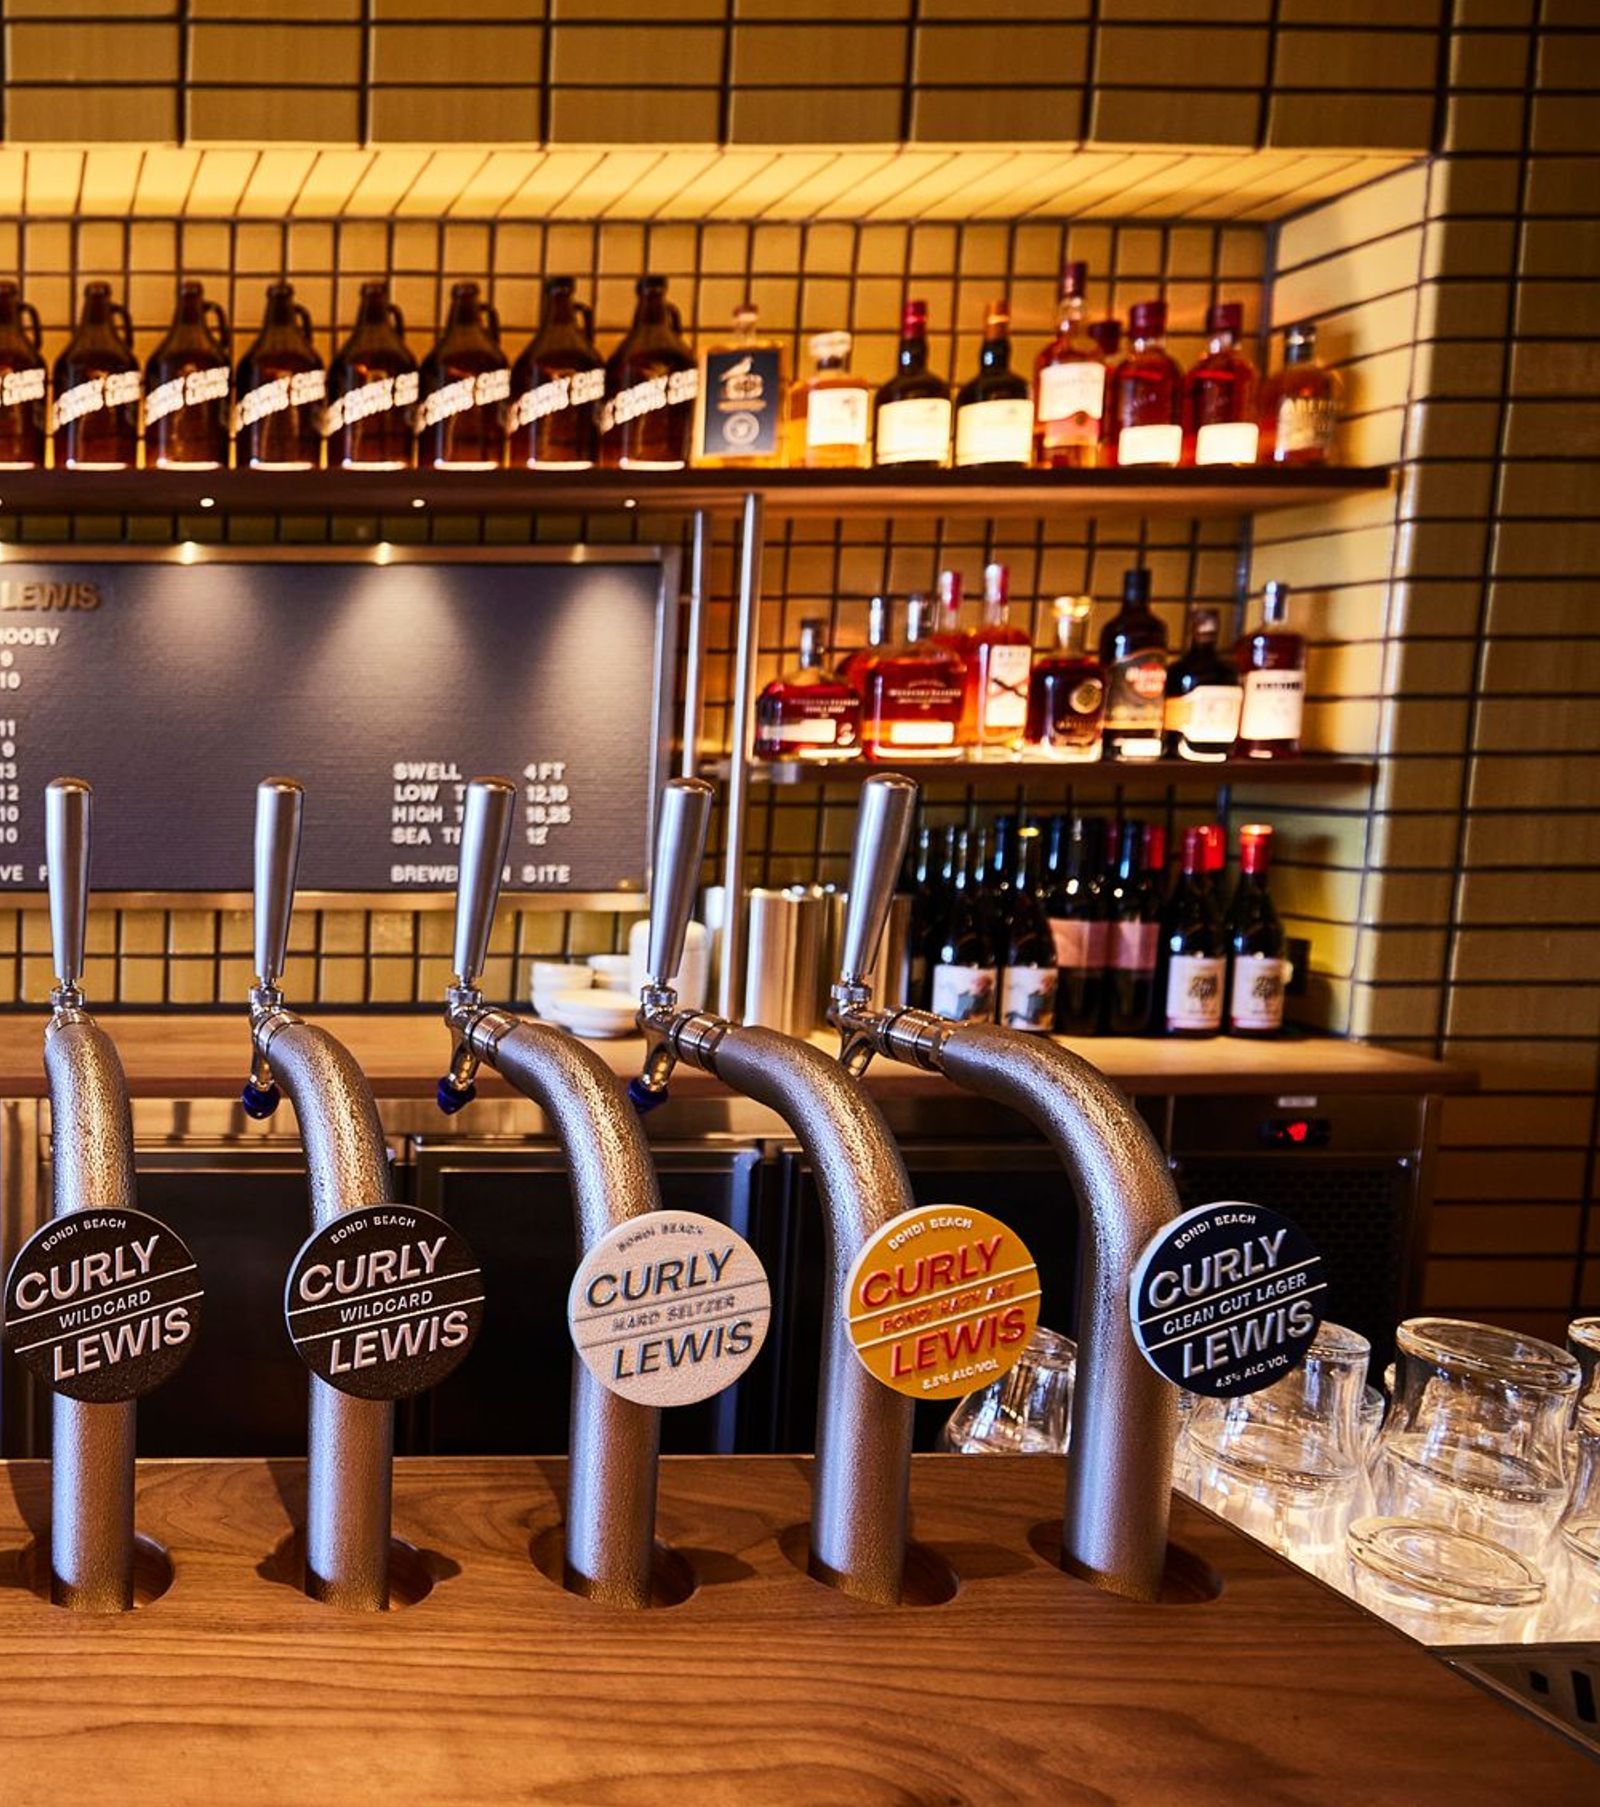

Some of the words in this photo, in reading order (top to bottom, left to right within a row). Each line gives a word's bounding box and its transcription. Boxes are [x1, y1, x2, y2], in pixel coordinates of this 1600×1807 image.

[0, 580, 101, 609] LEWIS
[393, 762, 461, 781] SWELL
[394, 784, 438, 803] LOW
[392, 805, 443, 823] HIGH
[391, 826, 432, 845] SEA
[390, 865, 459, 883] BREWE
[521, 865, 570, 883] SITE
[41, 1225, 78, 1251] BONDI
[82, 1218, 127, 1230] BEACH
[330, 1218, 368, 1245] BONDI
[373, 1215, 417, 1228] BEACH
[888, 1222, 926, 1250] BONDI
[929, 1216, 972, 1229] BEACH
[1174, 1221, 1211, 1250] BONDI
[1214, 1214, 1256, 1227] BEACH
[14, 1235, 160, 1310] CURLY
[300, 1236, 447, 1301] CURLY
[586, 1245, 735, 1308] CURLY
[860, 1234, 1002, 1308] CURLY
[1148, 1228, 1288, 1309] CURLY
[58, 1290, 151, 1329] WILDCARD
[340, 1290, 433, 1323] WILDCARD
[612, 1311, 660, 1331] HARD
[666, 1295, 735, 1322] SELTZER
[1162, 1307, 1215, 1336] CLEAN
[1218, 1295, 1251, 1317] CUT
[1256, 1273, 1308, 1303] LAGER
[52, 1307, 191, 1381] LEWIS
[329, 1310, 469, 1375] LEWIS
[613, 1320, 752, 1380] LEWIS
[890, 1307, 1026, 1379] LEWIS
[1183, 1300, 1315, 1378] LEWIS
